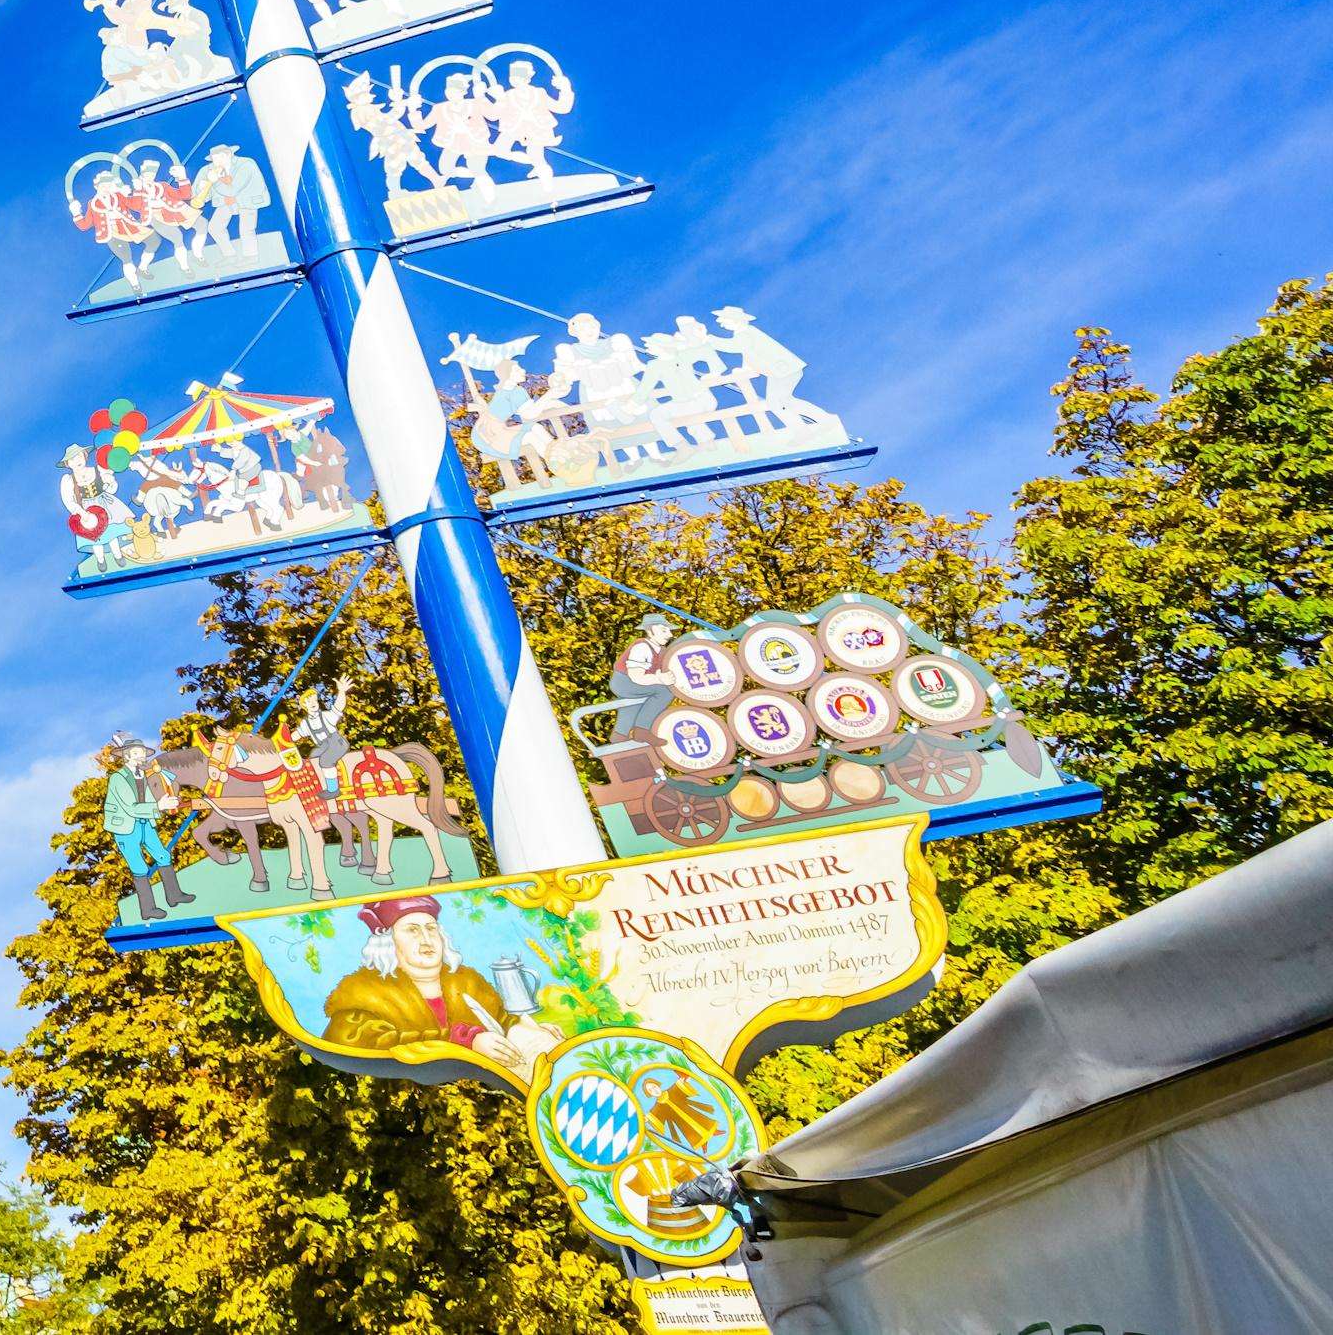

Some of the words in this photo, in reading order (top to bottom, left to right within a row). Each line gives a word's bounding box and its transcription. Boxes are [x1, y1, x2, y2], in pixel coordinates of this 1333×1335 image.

[682, 736, 708, 756] HB
[643, 854, 853, 902] MÜNCHNER
[613, 879, 900, 943] REINHEITSGEBOT
[745, 929, 787, 947] Anno
[788, 917, 845, 941] Domini
[848, 912, 889, 939] 1487
[640, 960, 715, 993] Albrecht
[732, 961, 790, 992] Herzog
[793, 958, 822, 975] von
[828, 946, 893, 974] Bayern
[644, 1287, 664, 1300] Den
